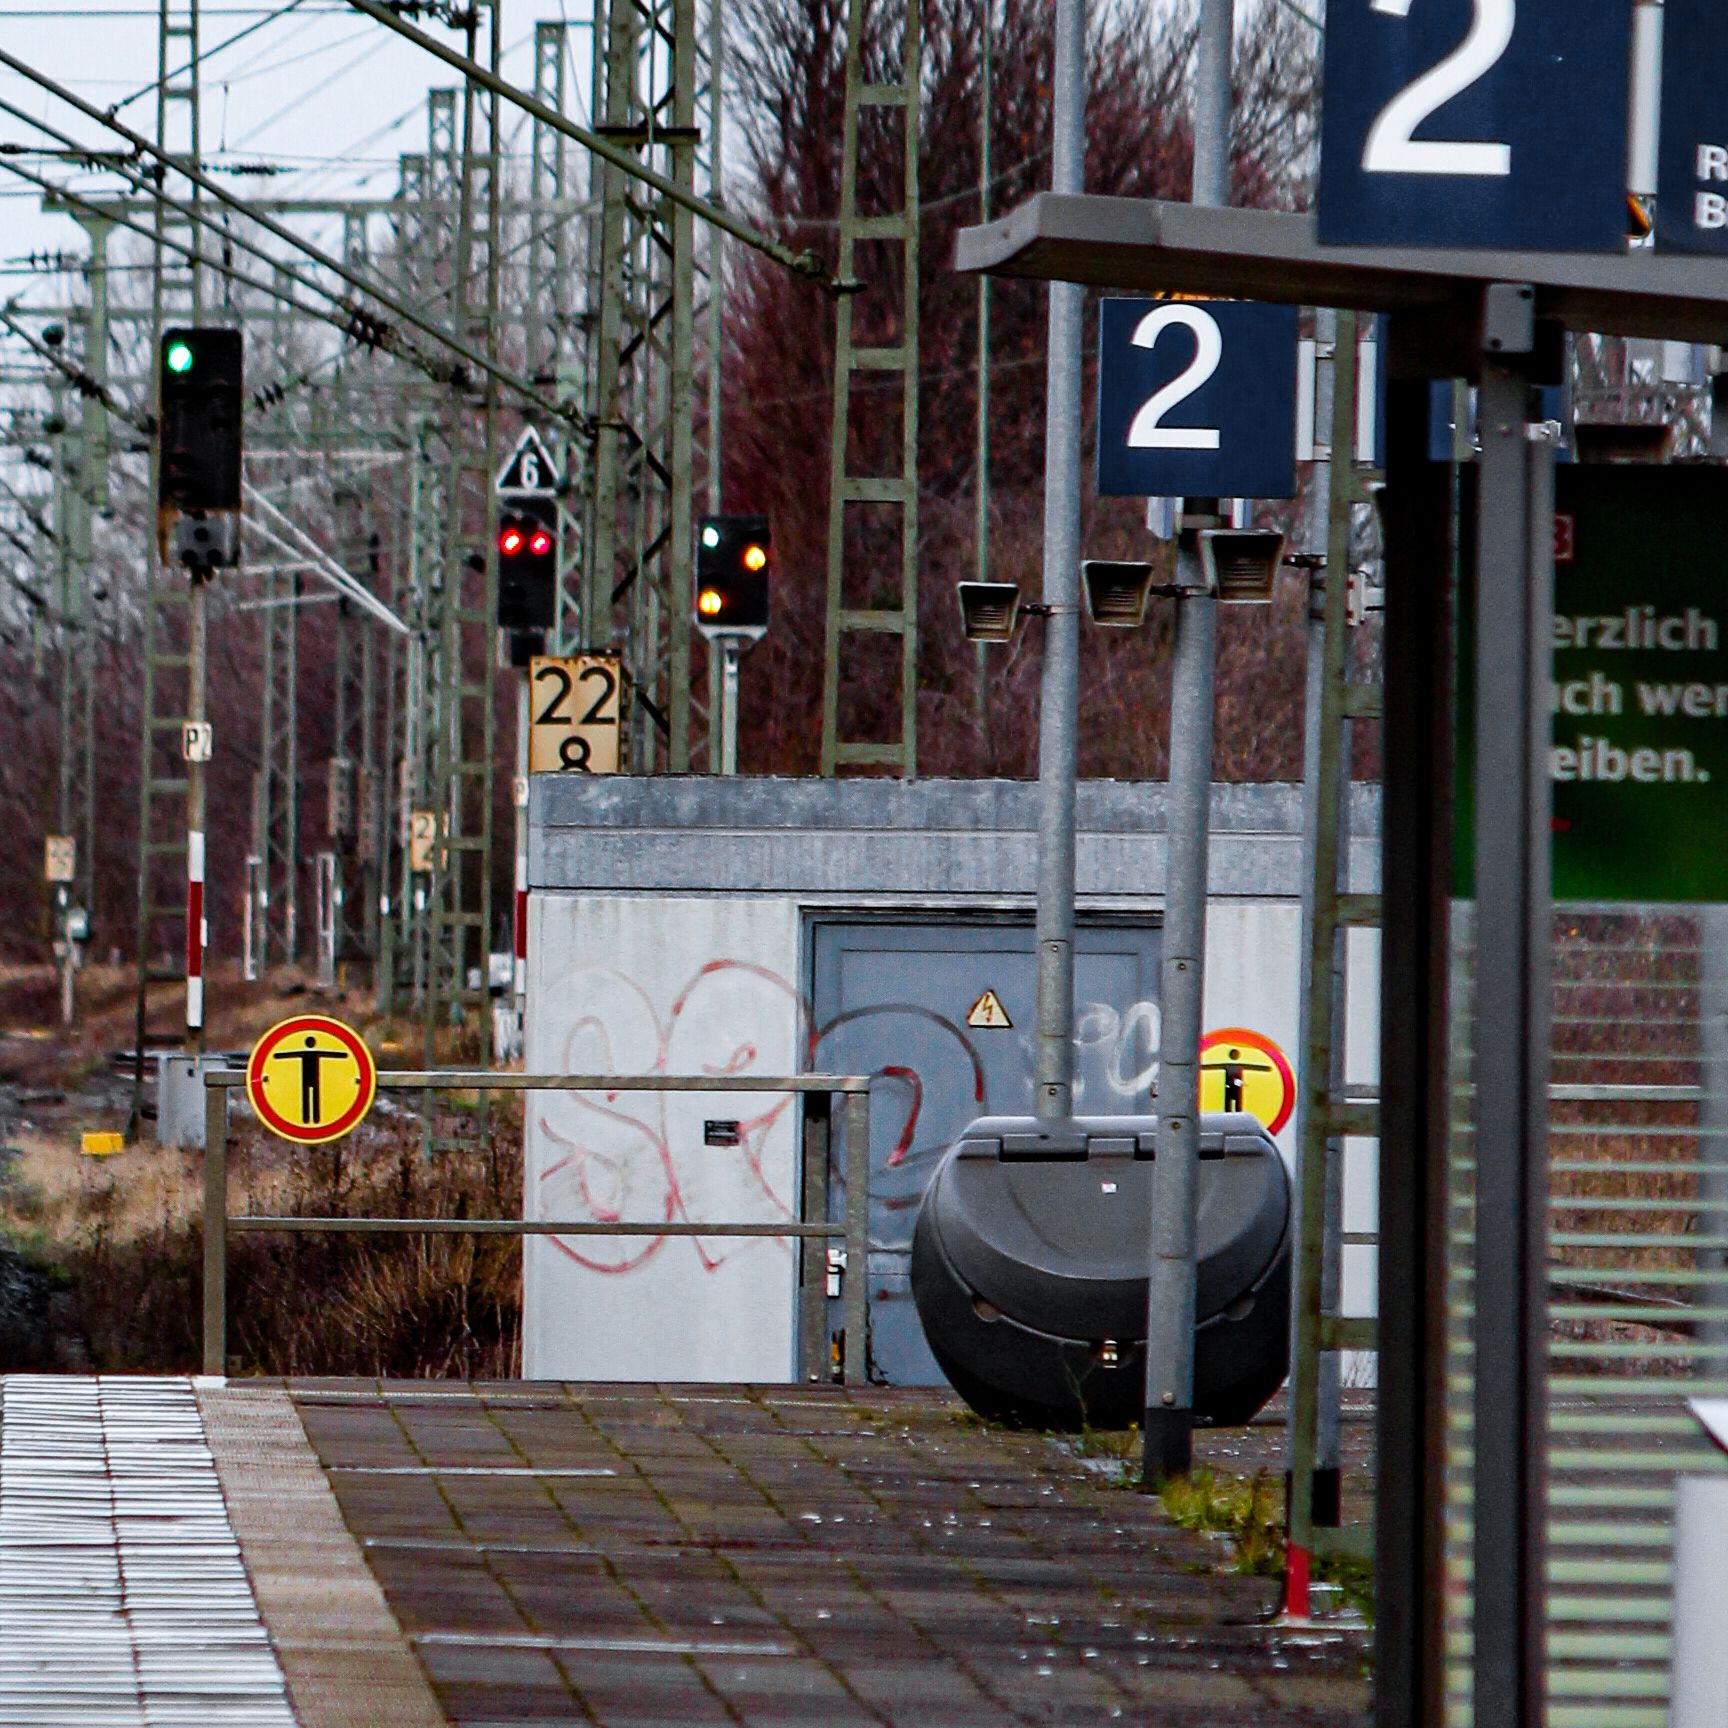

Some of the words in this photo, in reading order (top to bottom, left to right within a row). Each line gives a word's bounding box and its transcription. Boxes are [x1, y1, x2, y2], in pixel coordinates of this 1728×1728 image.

[1696, 143, 1728, 182] R
[1694, 190, 1728, 229] B
[1125, 302, 1223, 449] 2
[520, 453, 540, 491] 6
[1553, 605, 1718, 651] erzlich
[534, 665, 617, 725] 22
[559, 735, 593, 772] 8
[1550, 735, 1712, 783] eiben.
